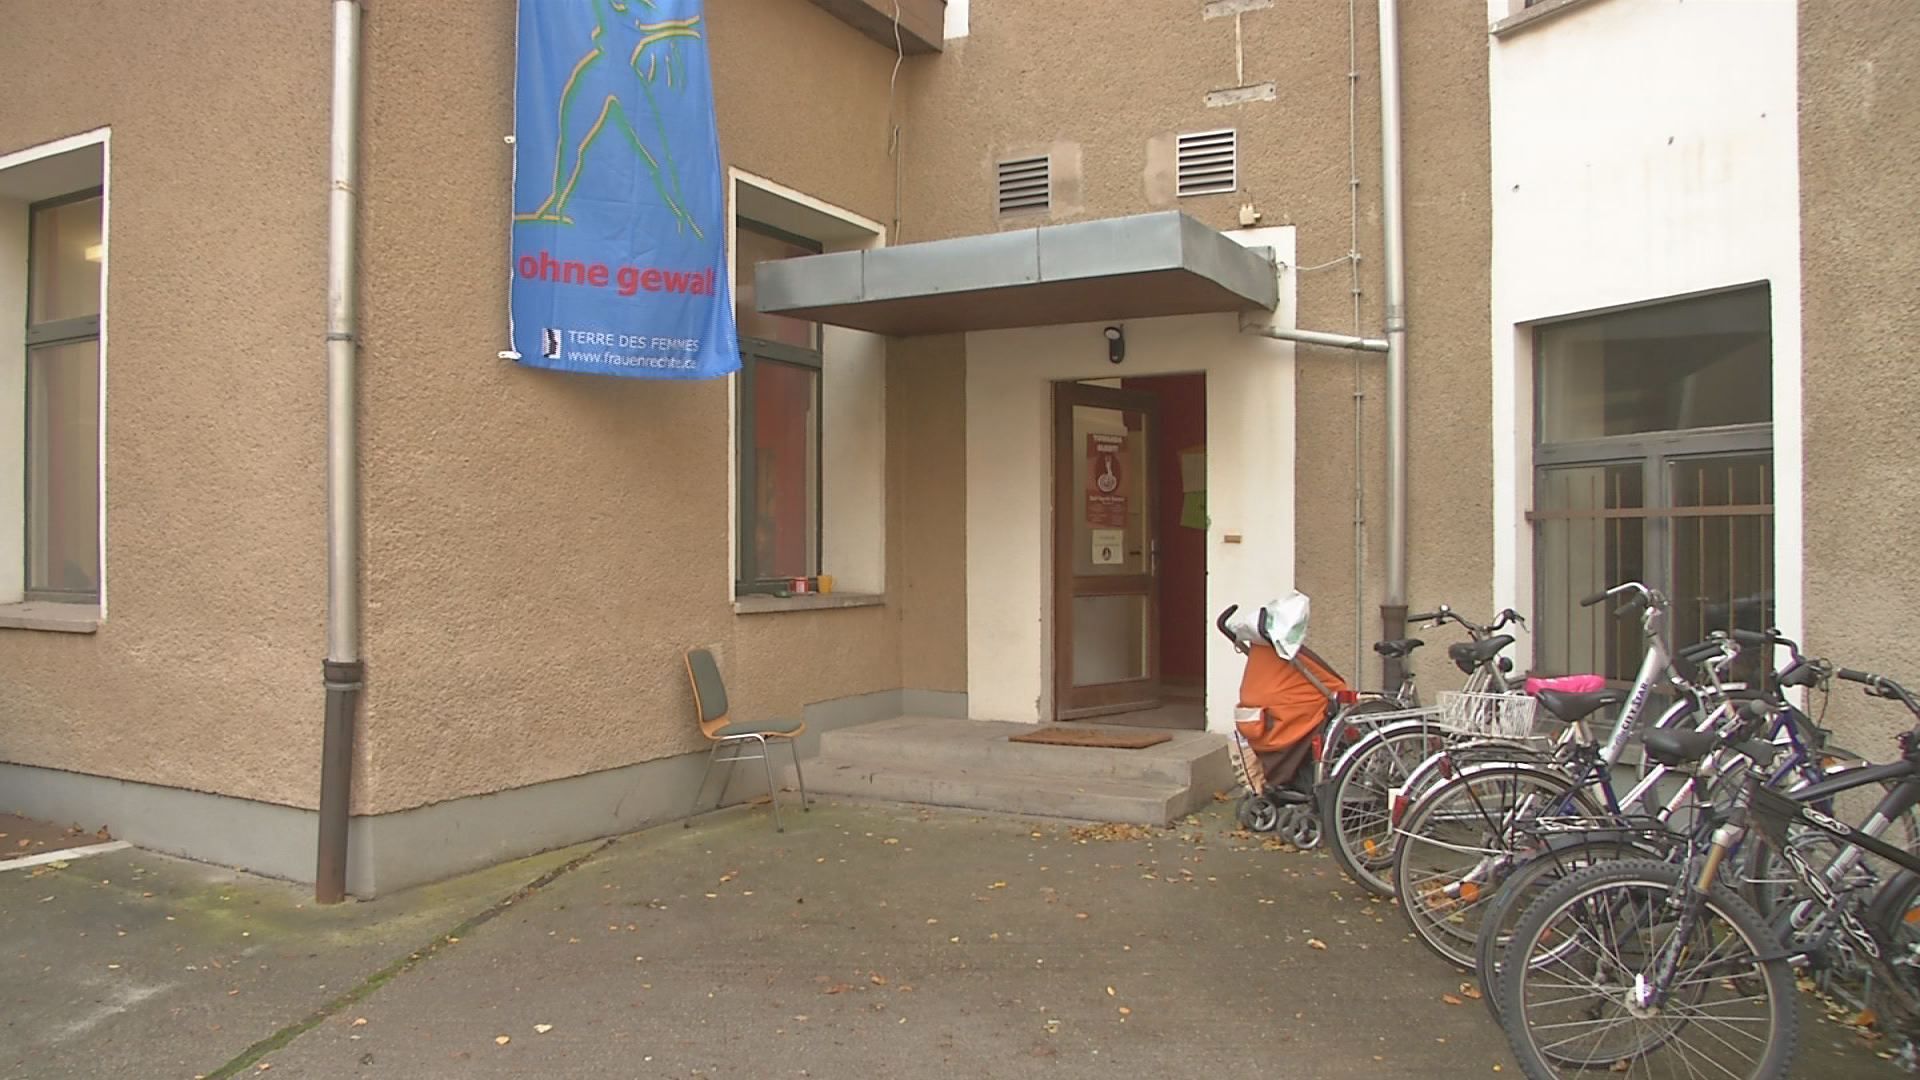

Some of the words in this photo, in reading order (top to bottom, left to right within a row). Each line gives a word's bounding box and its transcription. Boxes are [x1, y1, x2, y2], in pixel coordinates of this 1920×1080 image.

[519, 250, 609, 287] ohne
[616, 265, 715, 297] gewal
[567, 330, 614, 346] TERRE
[619, 335, 646, 349] DES
[651, 337, 699, 352] FEMMES
